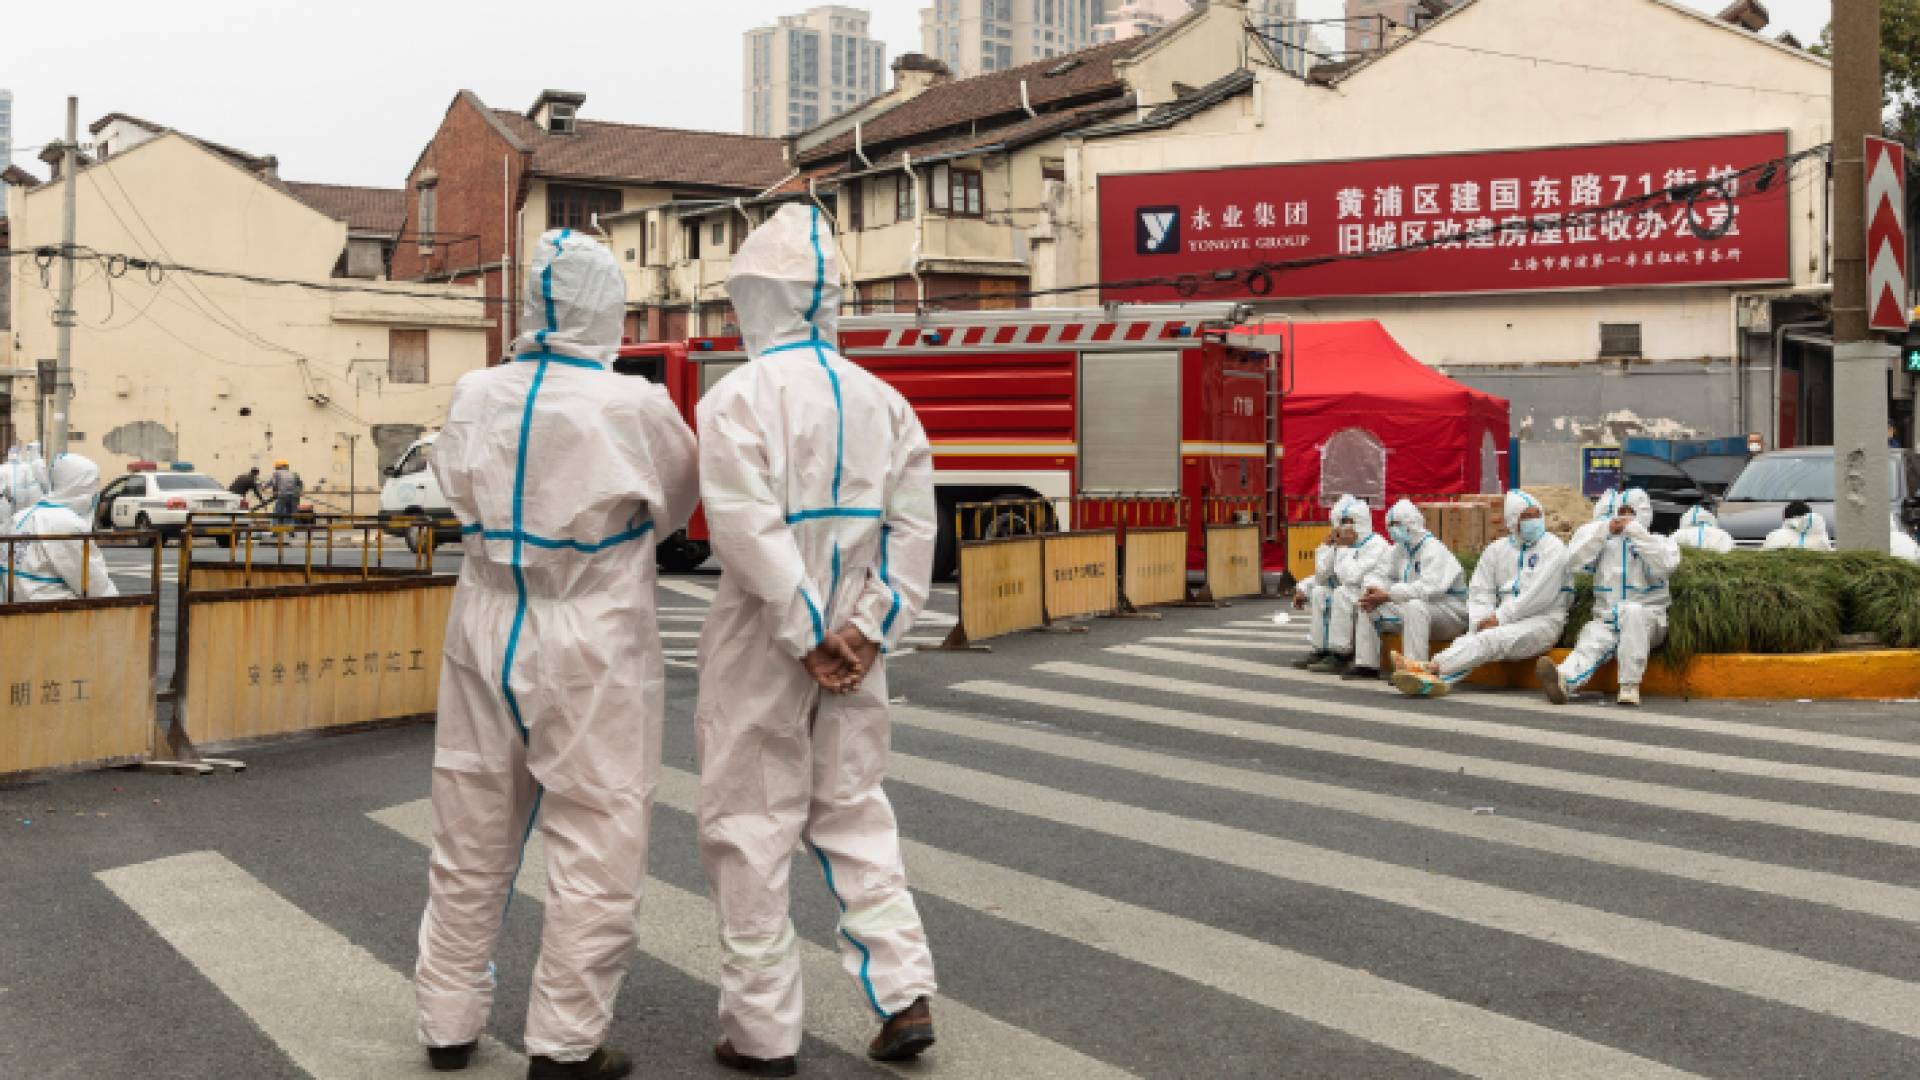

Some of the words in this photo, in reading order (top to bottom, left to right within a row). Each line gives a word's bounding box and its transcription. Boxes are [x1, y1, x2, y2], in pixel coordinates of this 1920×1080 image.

[1191, 200, 1308, 230] 永业集团
[1188, 237, 1251, 252] YONGYE
[1255, 234, 1311, 249] GROUP
